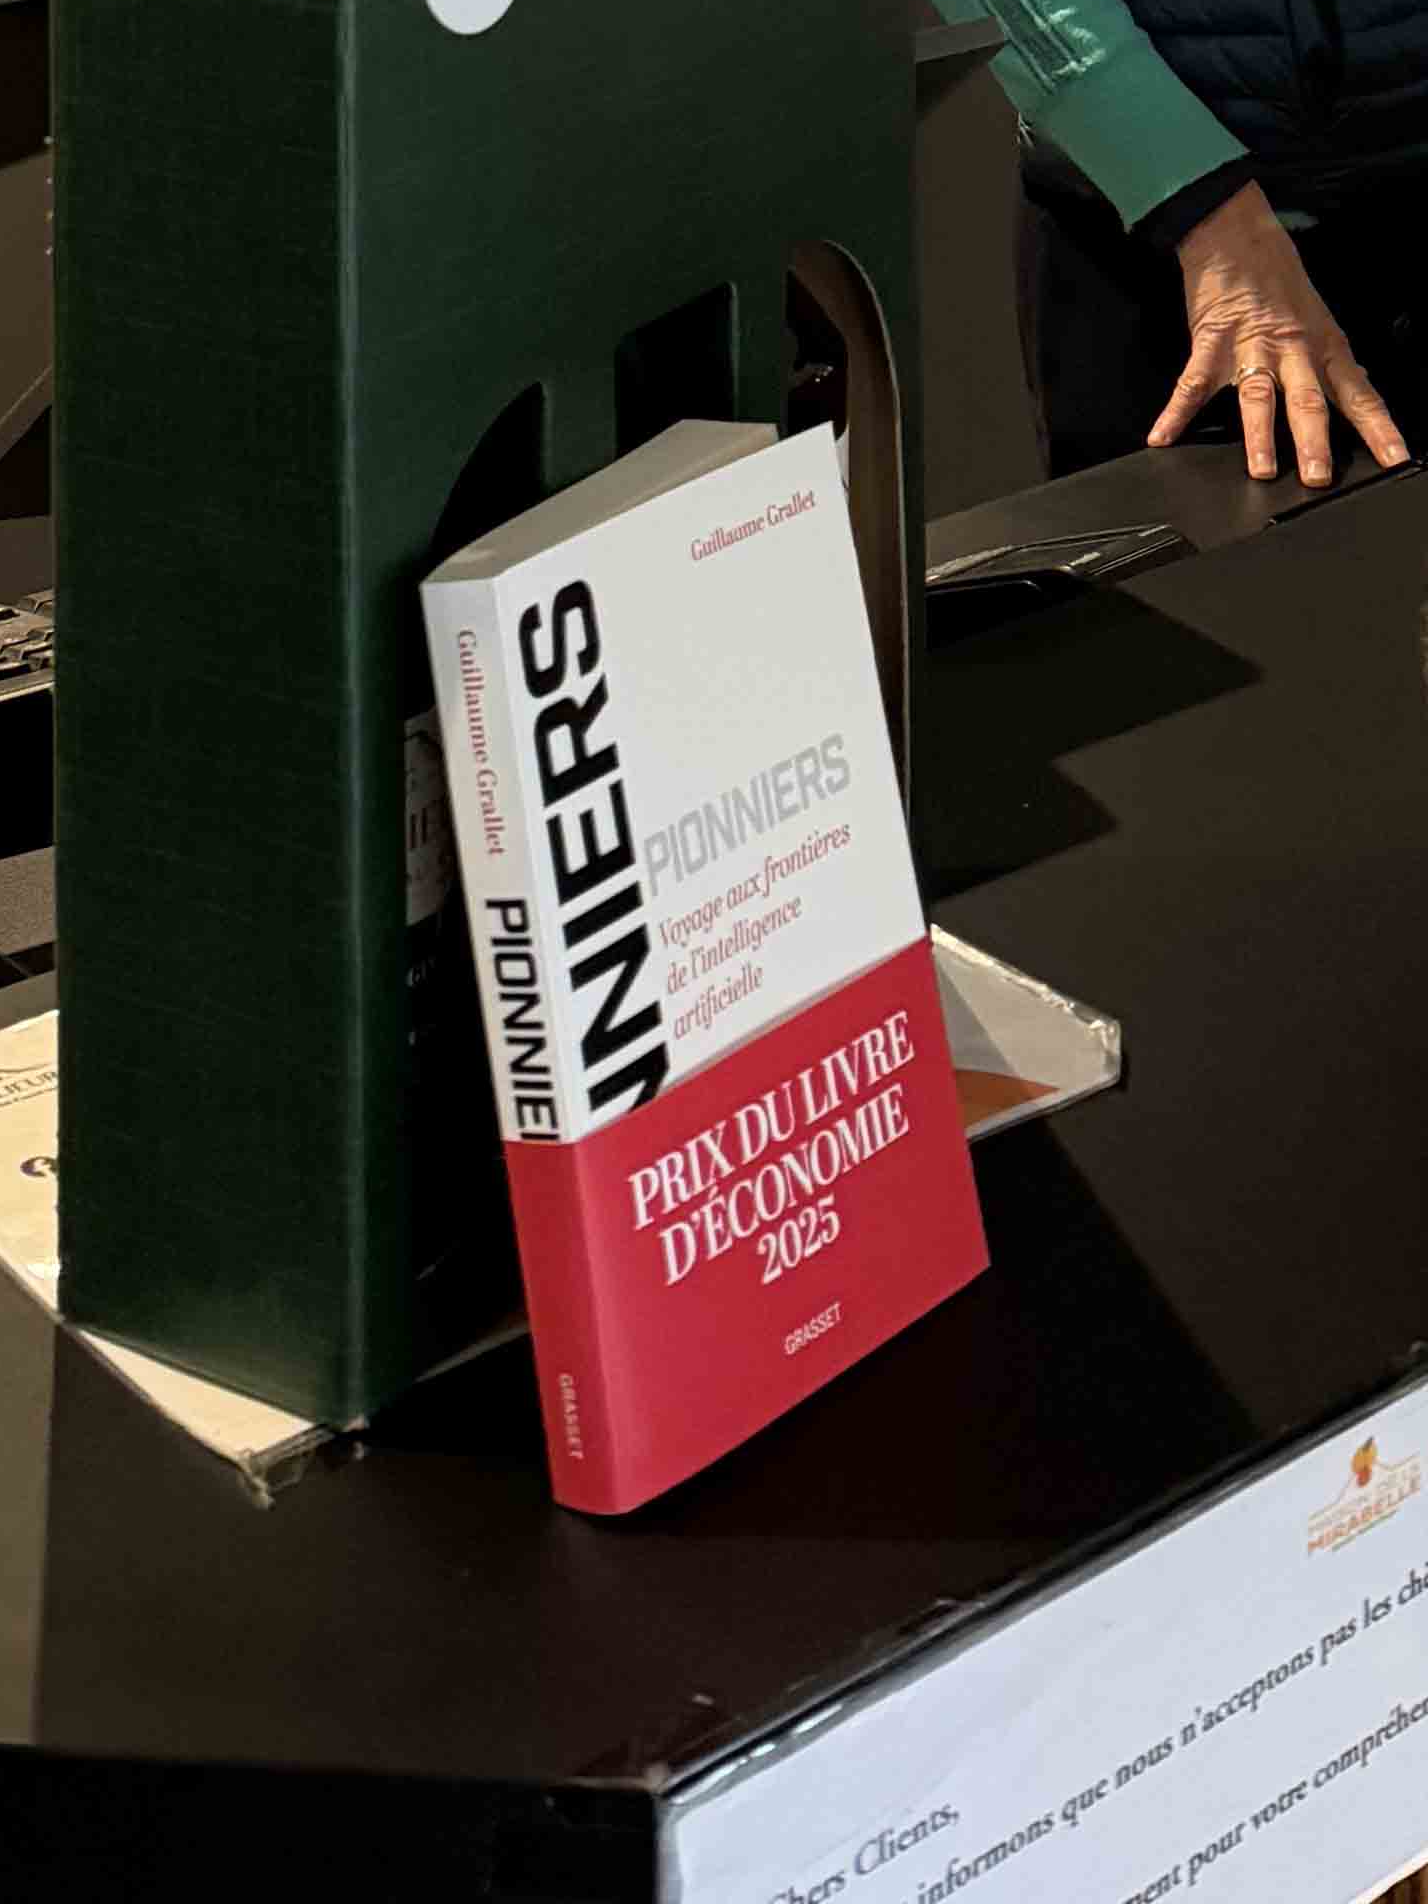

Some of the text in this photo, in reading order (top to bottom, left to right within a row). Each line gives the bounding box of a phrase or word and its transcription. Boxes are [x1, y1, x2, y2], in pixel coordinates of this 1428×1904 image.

[690, 490, 817, 561] Guillaume Grallet
[456, 628, 507, 856] Guillaume Grallet
[643, 733, 851, 898] PIONNIERS
[658, 823, 851, 949] Voyage aux frontières
[485, 896, 562, 1144] PIONNIE
[667, 959, 688, 995] de
[673, 964, 764, 1040] artificielle
[627, 1009, 916, 1232] PRIX DU LIVRE
[658, 1082, 910, 1286] D'ÉCONOMIE
[755, 1194, 841, 1285] 2025
[783, 1302, 843, 1356] GRASSET
[558, 1373, 584, 1459] GRASSET
[915, 1811, 1056, 1904] informons
[1060, 1773, 1110, 1829] que
[1112, 1735, 1176, 1792] nous
[1178, 1644, 1316, 1748] n'acceptons
[1318, 1619, 1359, 1666] pas
[1361, 1594, 1394, 1630] les
[853, 1801, 961, 1877] Clients,
[1186, 1822, 1248, 1888] pour
[1249, 1781, 1309, 1833] votre
